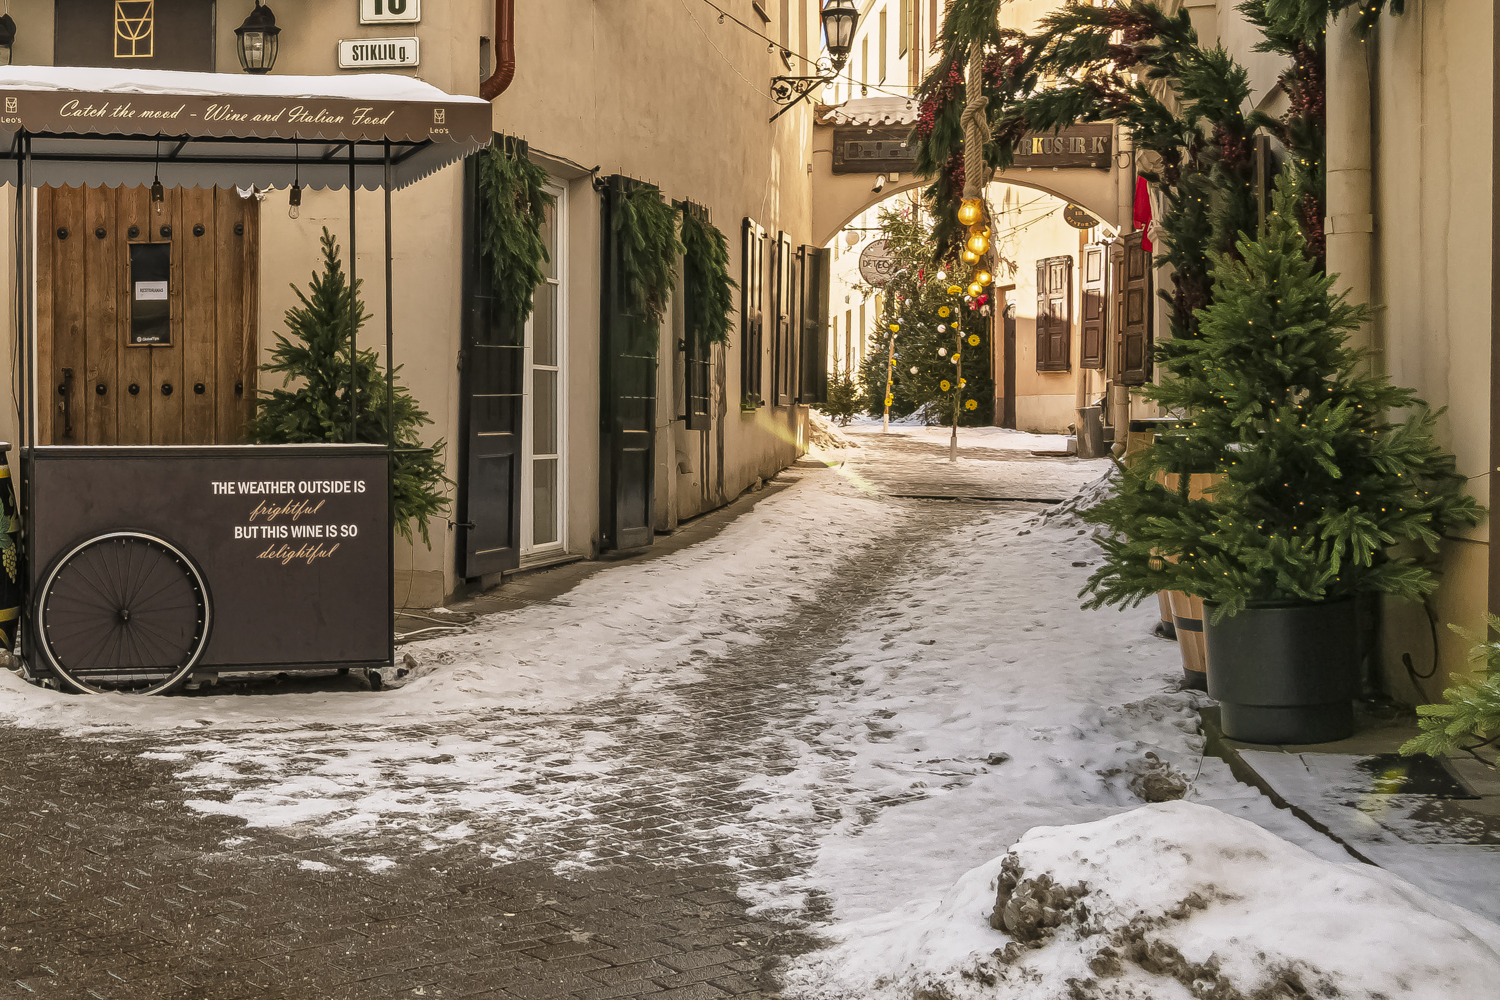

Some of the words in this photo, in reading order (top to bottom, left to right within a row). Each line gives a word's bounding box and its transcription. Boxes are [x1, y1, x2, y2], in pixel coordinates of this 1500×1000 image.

[399, 46, 410, 62] g.
[0, 115, 22, 124] Leo's
[59, 99, 109, 118] Catch
[108, 102, 134, 118] the
[137, 104, 186, 120] mood
[203, 103, 249, 122] Wine
[249, 107, 286, 122] and
[288, 106, 345, 124] Italian
[352, 106, 395, 125] Food
[429, 126, 450, 135] Leo's
[1069, 136, 1087, 154] IR
[212, 481, 236, 495] THE
[238, 481, 296, 494] WEATHER
[299, 480, 352, 494] OUTSIDE
[354, 480, 366, 493] IS
[249, 499, 326, 522] frightful
[234, 526, 259, 539] BUT
[261, 526, 289, 538] THIS
[291, 525, 323, 538] WINE
[326, 525, 338, 537] IS
[340, 524, 358, 537] SO
[256, 542, 340, 566] delightful
